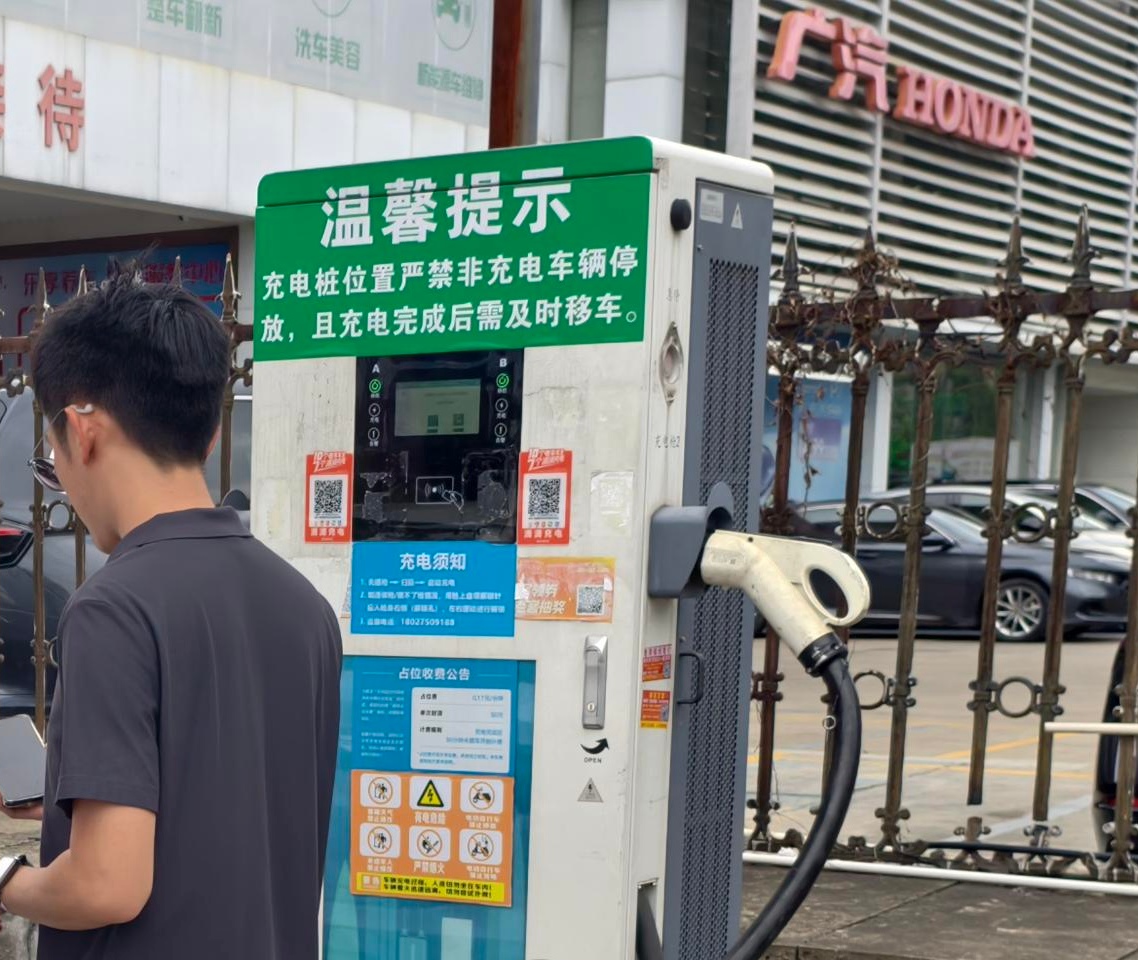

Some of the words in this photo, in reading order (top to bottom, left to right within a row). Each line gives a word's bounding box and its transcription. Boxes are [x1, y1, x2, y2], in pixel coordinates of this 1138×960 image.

[295, 26, 361, 72] 洗车美容
[767, 8, 890, 112] 广汽
[893, 66, 1036, 158] HONDA
[320, 167, 573, 248] 温馨提示
[262, 244, 639, 300] 充电桩位置严禁非充电车辆停
[260, 292, 639, 345] 放,且充电完成后需及时移车。
[372, 363, 381, 373] A
[499, 358, 508, 368] B
[400, 553, 467, 571] 充电须知
[398, 667, 471, 681] 占位收费公告
